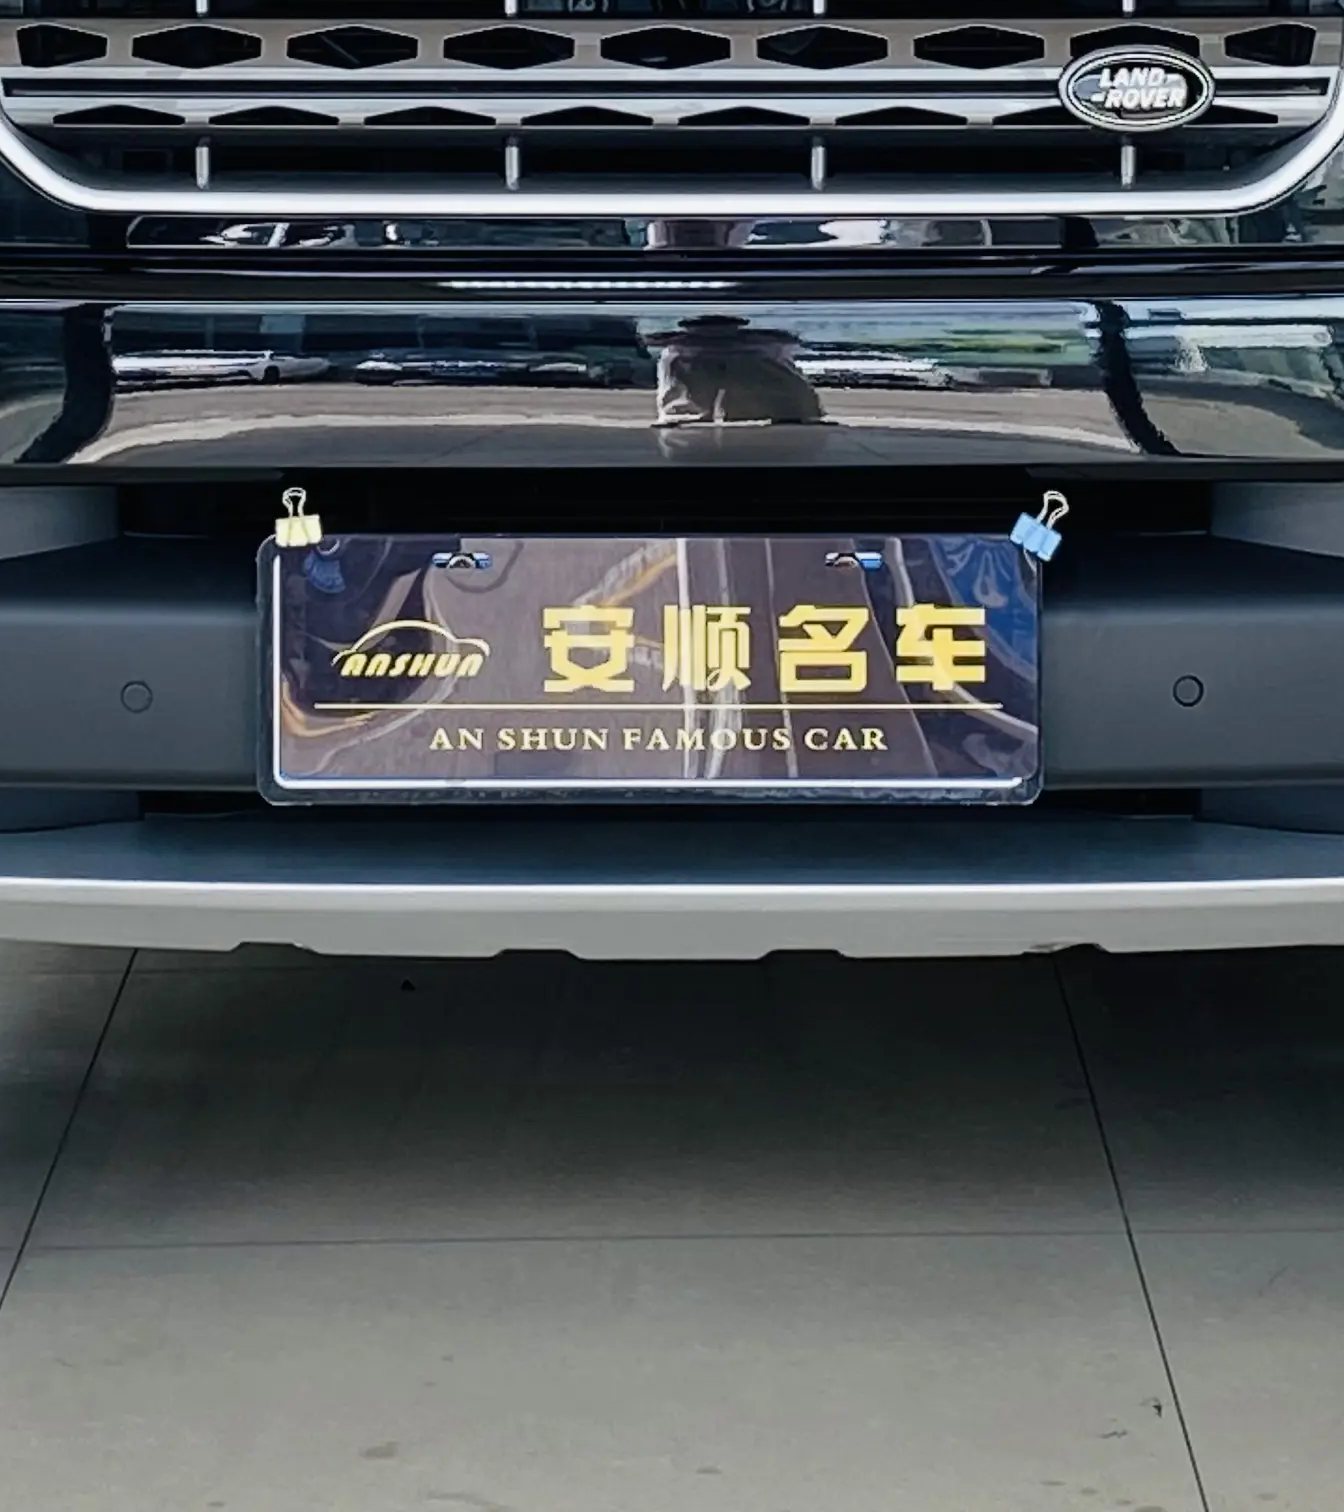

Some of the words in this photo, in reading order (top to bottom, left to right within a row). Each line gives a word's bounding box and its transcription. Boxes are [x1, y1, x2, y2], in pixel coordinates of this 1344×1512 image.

[1099, 67, 1165, 88] LAND
[1104, 88, 1187, 110] ROVER
[542, 604, 986, 693] 安顺名车
[429, 728, 485, 751] AN
[498, 727, 608, 752] SHUN
[624, 727, 792, 752] FAMOUS
[805, 727, 888, 752] CAR
